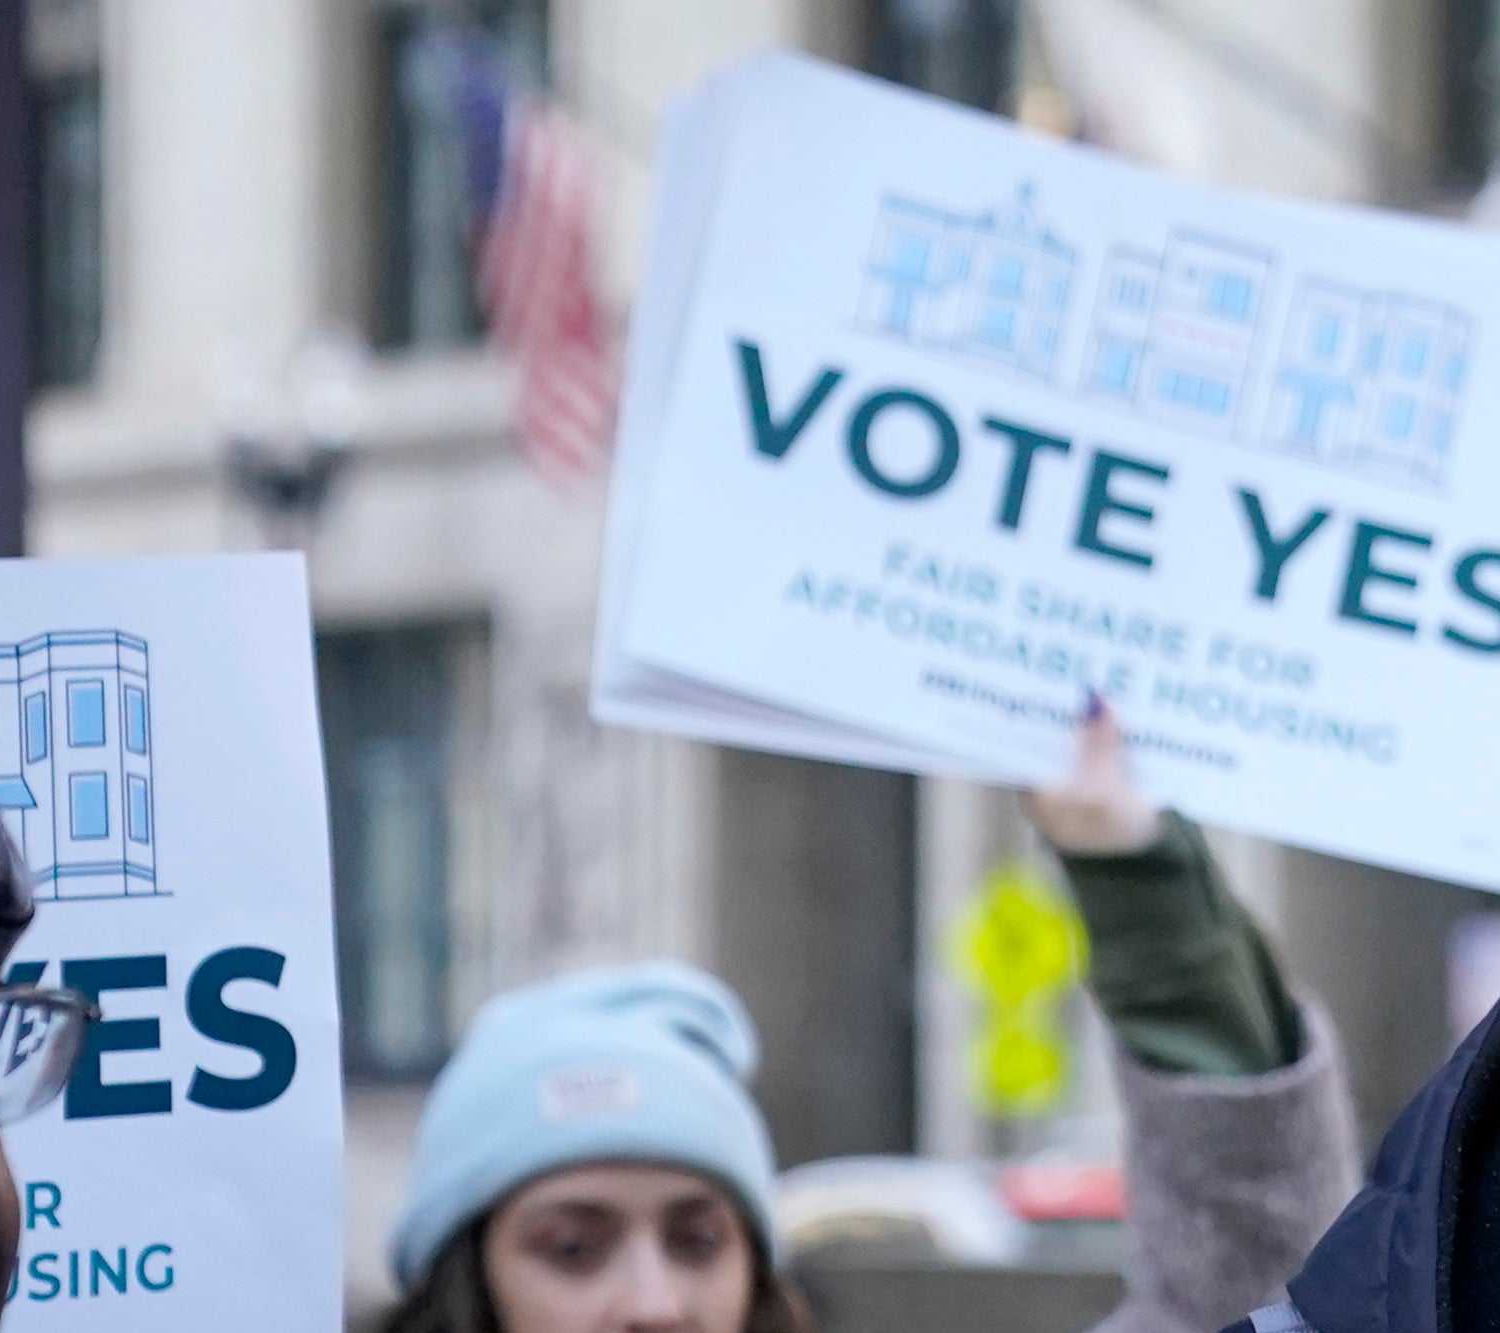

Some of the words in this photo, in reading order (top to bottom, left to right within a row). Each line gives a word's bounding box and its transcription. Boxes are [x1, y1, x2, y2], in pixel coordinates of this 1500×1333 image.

[729, 335, 1172, 574] VOTE
[882, 540, 998, 608] FAIR
[1014, 579, 1192, 657] SHARE
[1206, 632, 1316, 688] FOR
[1152, 672, 1399, 764] HOUSING
